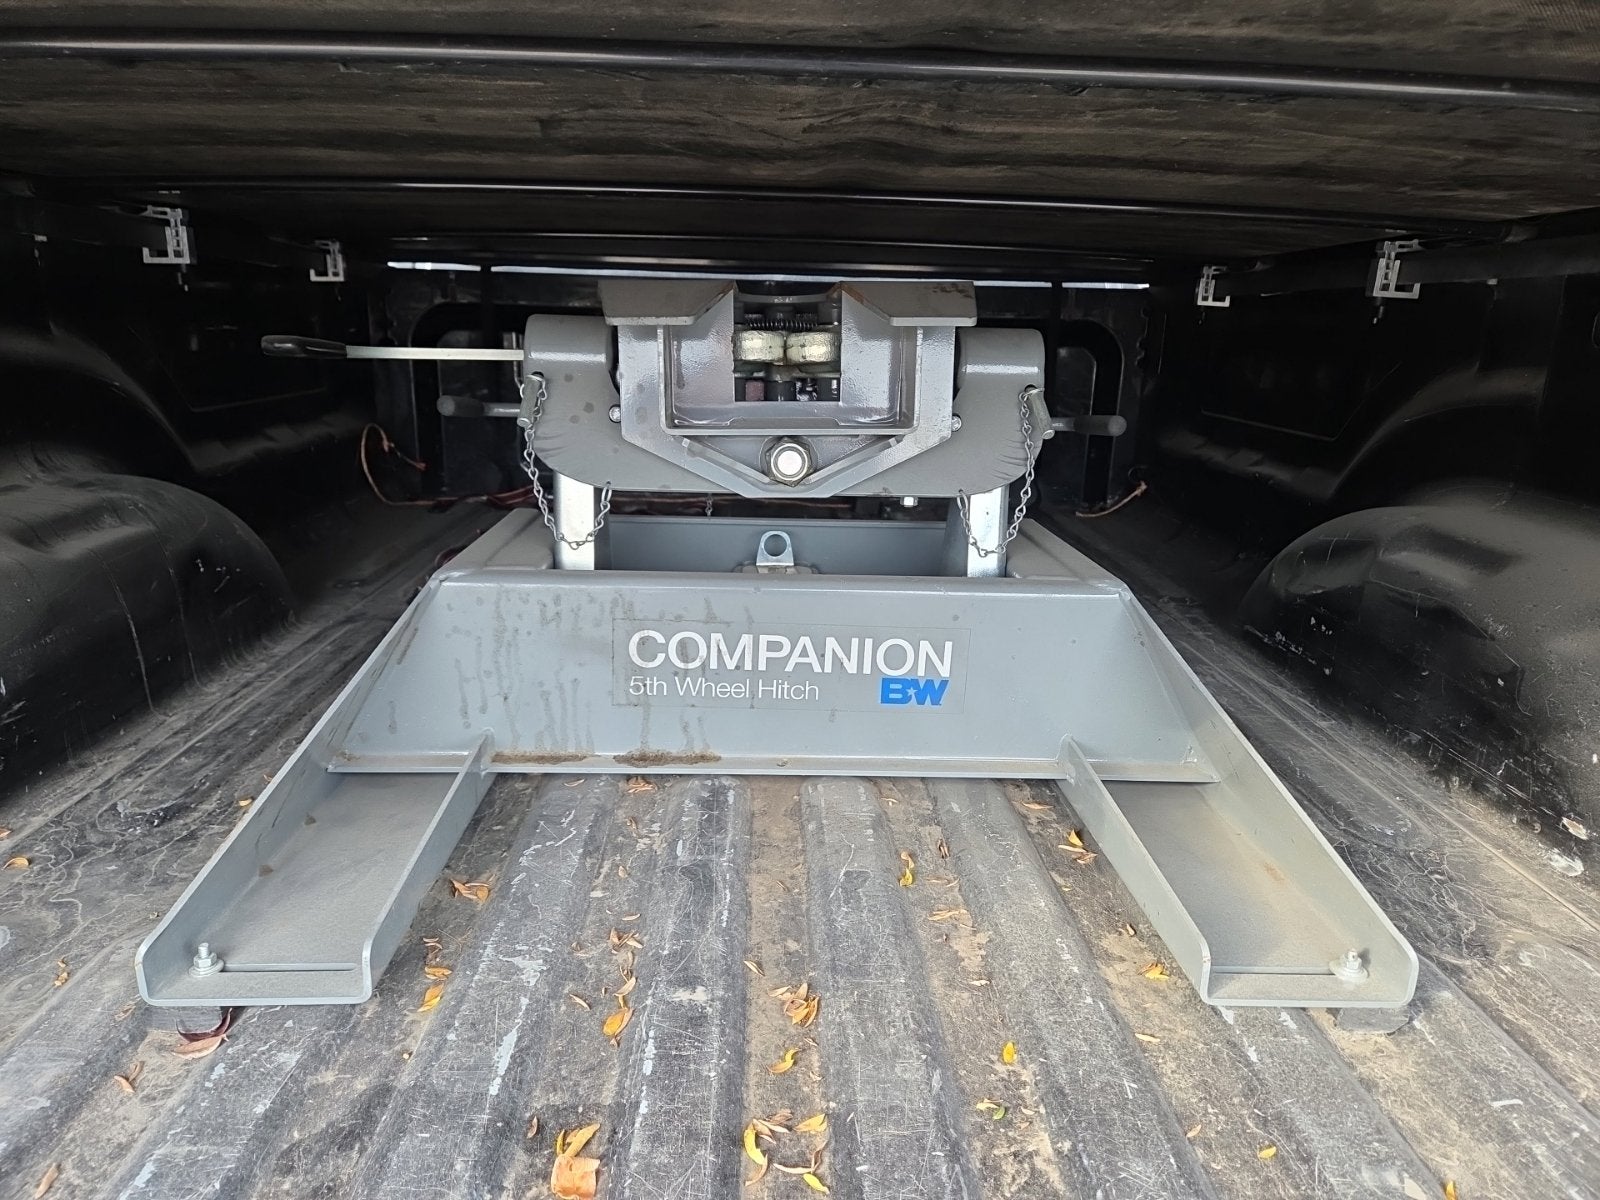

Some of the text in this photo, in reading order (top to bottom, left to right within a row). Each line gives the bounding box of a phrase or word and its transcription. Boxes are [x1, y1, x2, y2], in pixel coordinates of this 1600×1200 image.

[628, 629, 953, 678] COMPANION
[629, 676, 819, 701] 5th Wheel Hitch
